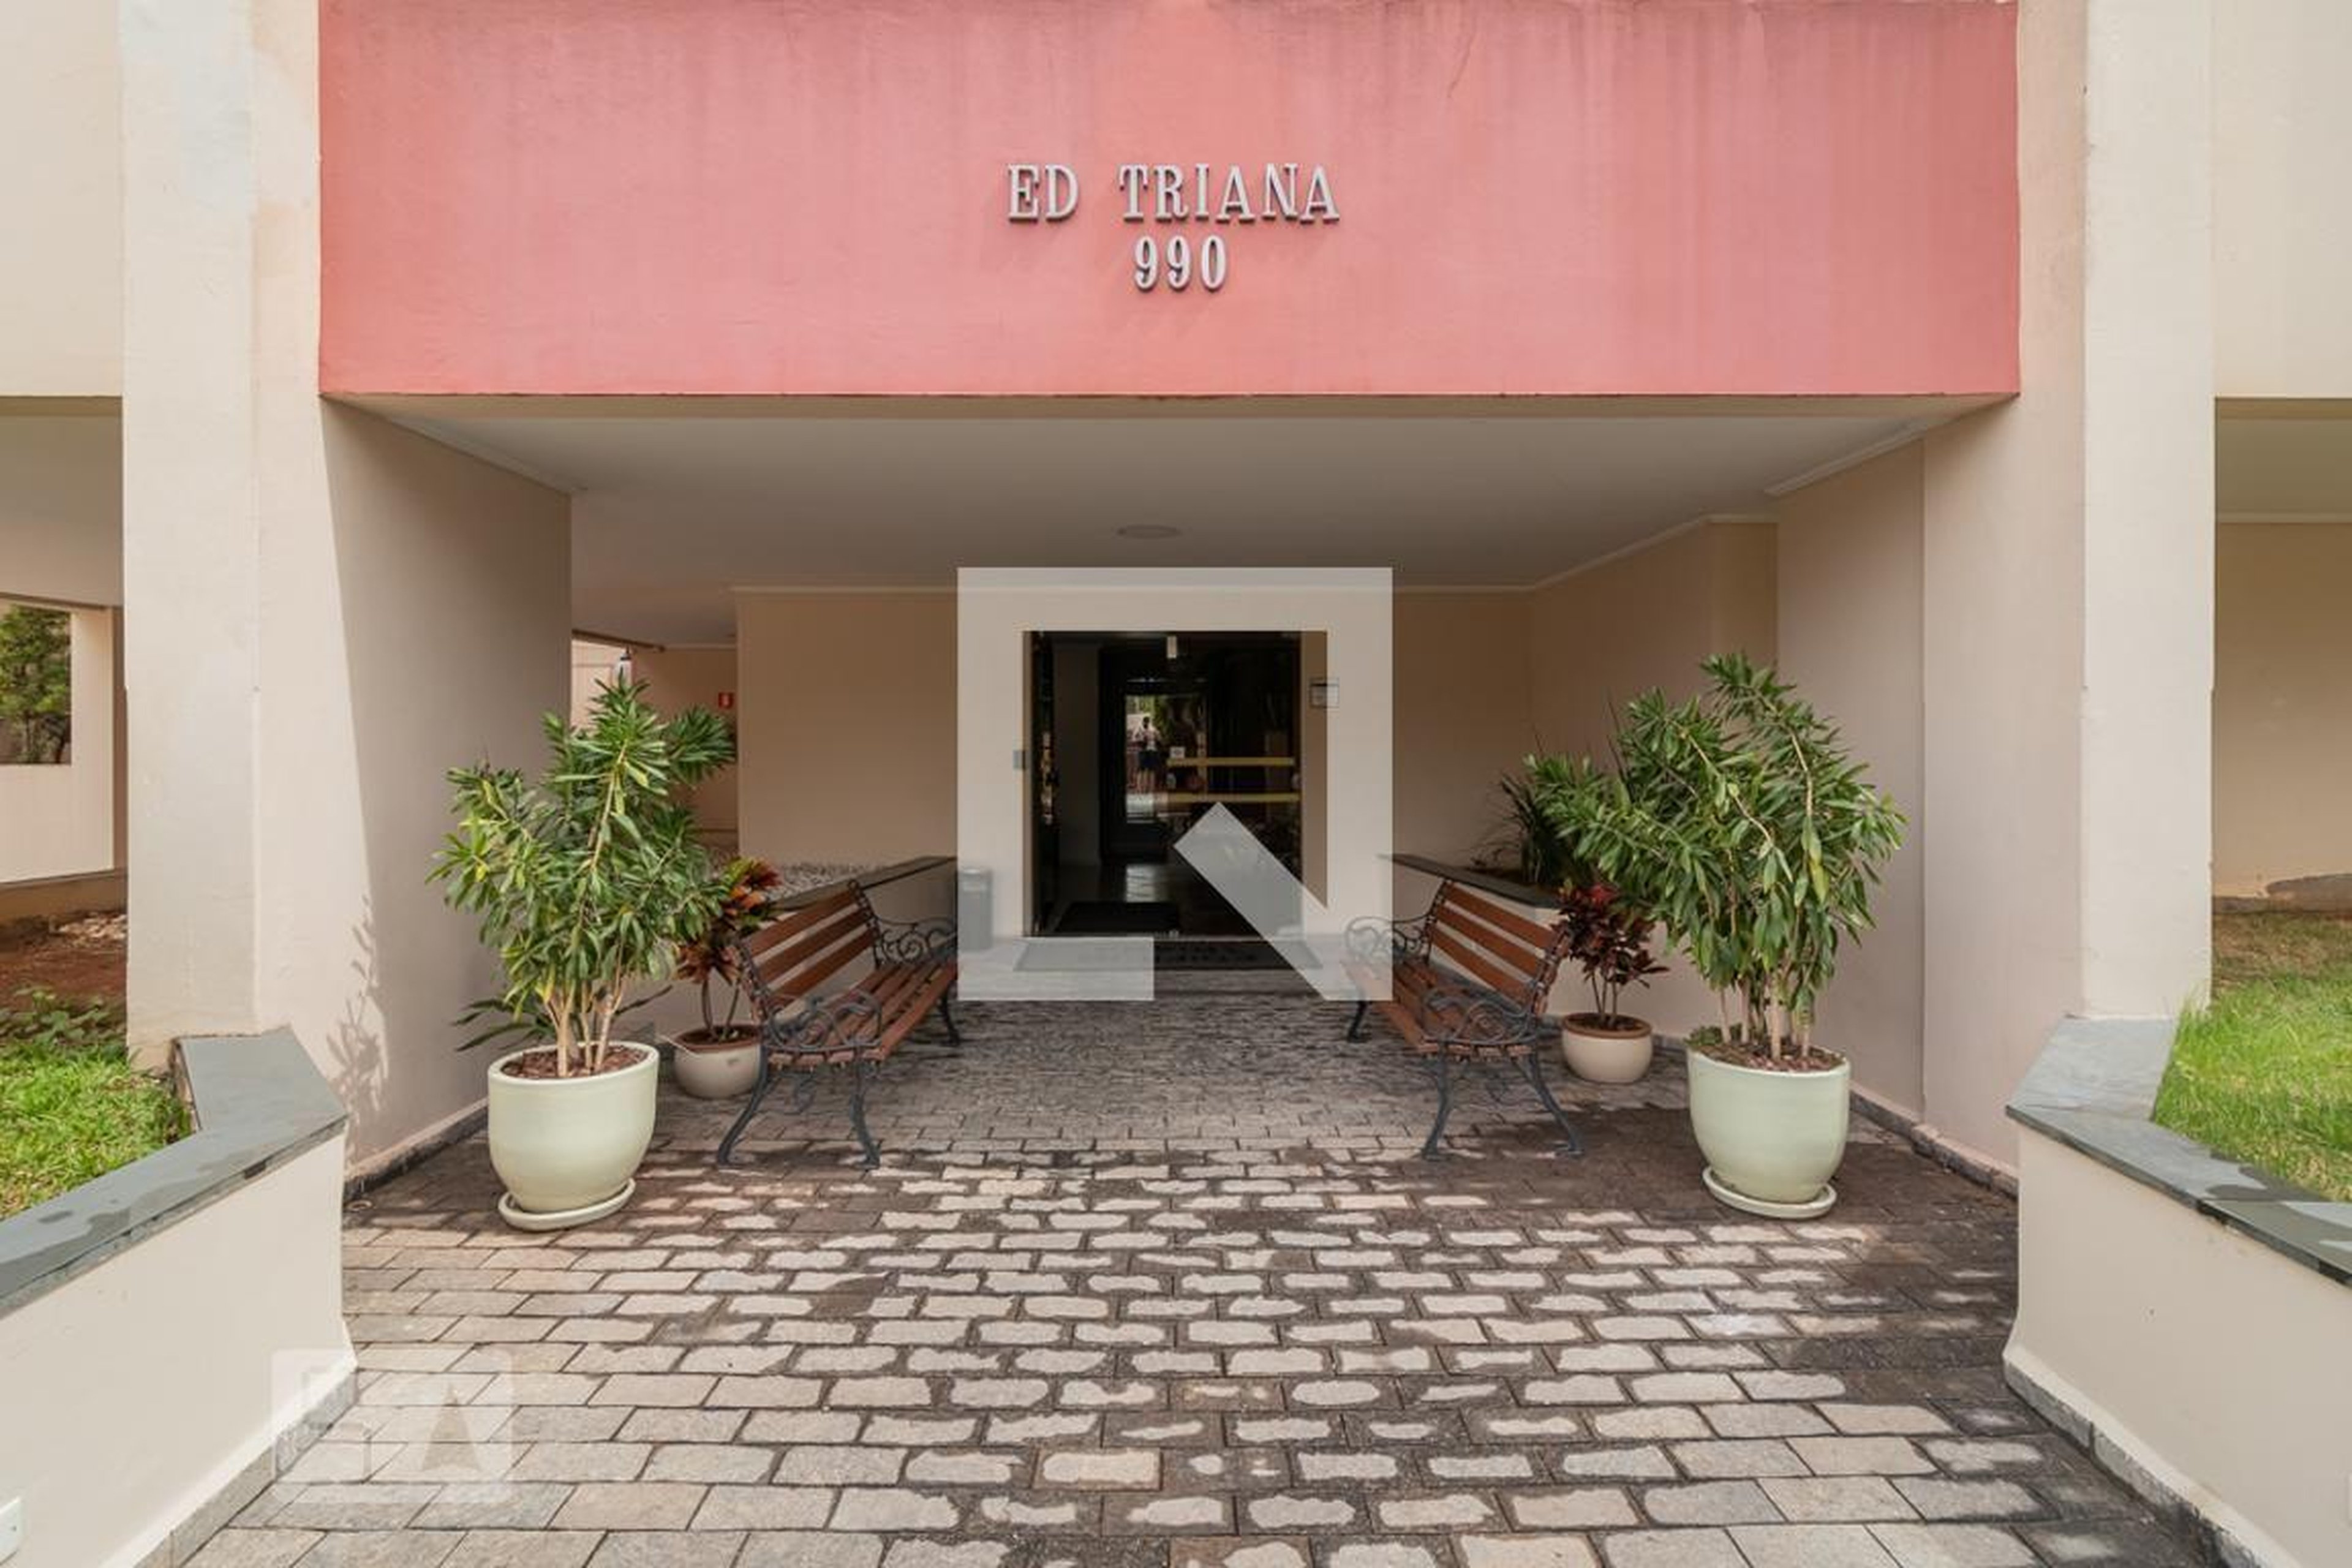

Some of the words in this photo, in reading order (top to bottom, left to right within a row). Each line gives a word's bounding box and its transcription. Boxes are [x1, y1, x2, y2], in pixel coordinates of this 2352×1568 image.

[1008, 163, 1079, 221] ED
[1118, 162, 1340, 222] TRIANA
[1134, 235, 1226, 290] 990
